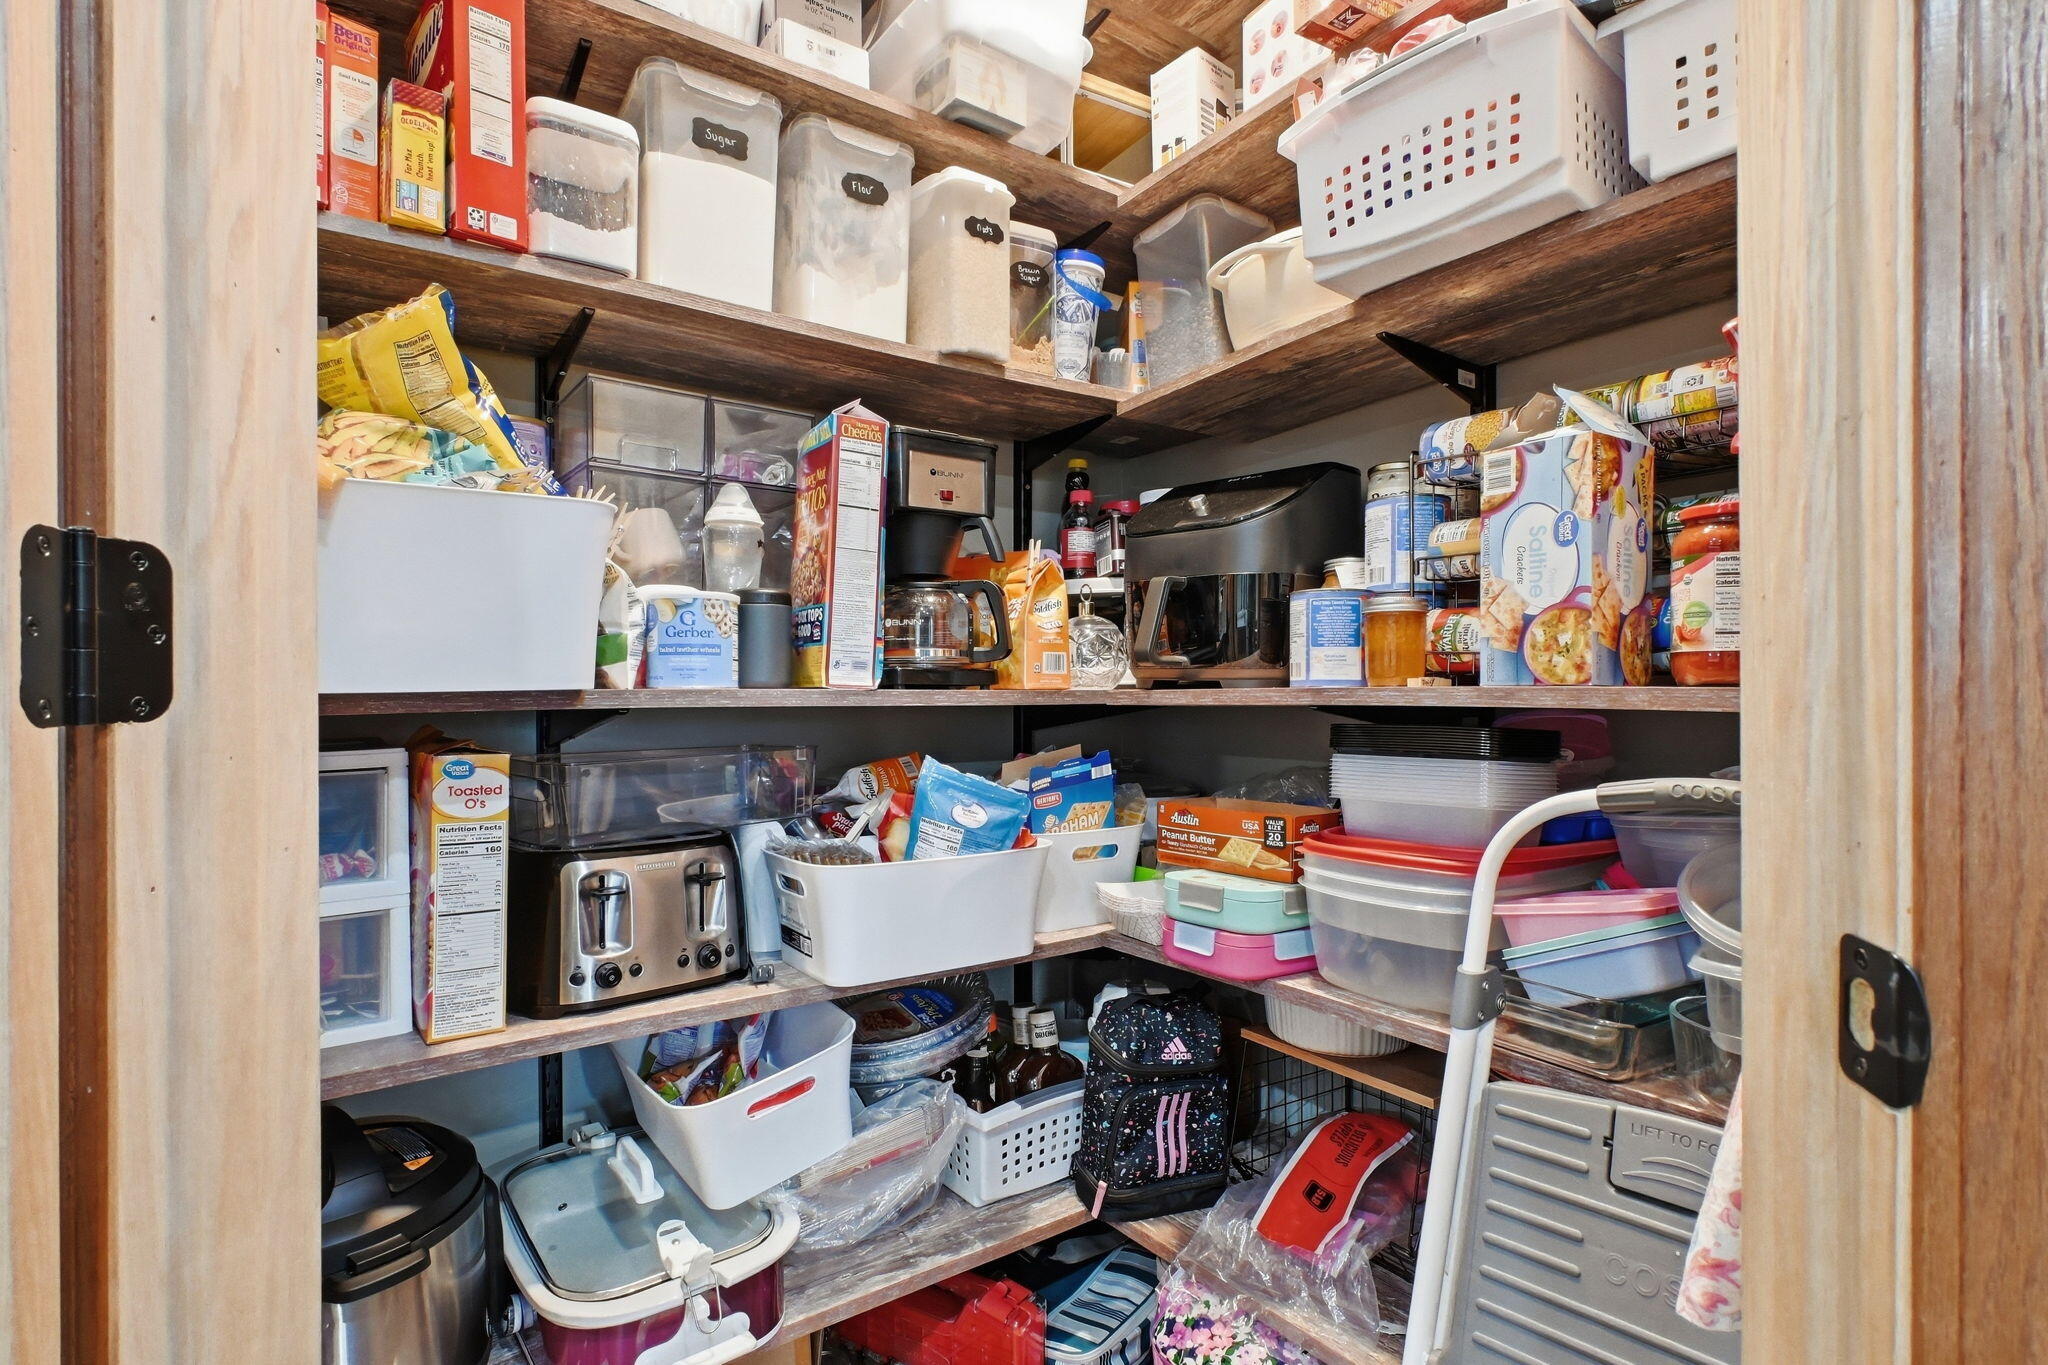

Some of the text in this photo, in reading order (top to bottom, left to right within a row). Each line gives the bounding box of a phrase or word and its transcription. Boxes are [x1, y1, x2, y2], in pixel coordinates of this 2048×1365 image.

[470, 32, 491, 44] Calories
[705, 128, 738, 149] Sugar
[1018, 265, 1041, 274] Brown
[1020, 273, 1041, 285] Sugar
[841, 423, 882, 442] Cheerios
[937, 470, 964, 478] BUNN
[1564, 514, 1574, 541] Great
[1516, 545, 1527, 585] Crackers
[1529, 525, 1548, 598] Saltine
[1623, 525, 1634, 599] Saltine
[891, 618, 922, 626] BUNN
[665, 625, 714, 638] Gerber
[446, 764, 469, 772] Great
[860, 768, 878, 800] Goldfish
[448, 785, 503, 797] Toasted
[465, 798, 487, 810] O's
[832, 812, 854, 827] Snac
[1170, 811, 1200, 826] Austin
[1241, 819, 1284, 830] USA VALUE
[921, 817, 963, 835] Nutrition Facts
[1300, 822, 1320, 834] Austin
[1161, 829, 1216, 845] Peanut Butter
[1268, 833, 1281, 841] 20
[485, 845, 502, 853] 160
[1161, 1051, 1192, 1060] adidas
[1631, 1122, 1720, 1158] LIFT TO FO
[1605, 1252, 1682, 1308] COS
